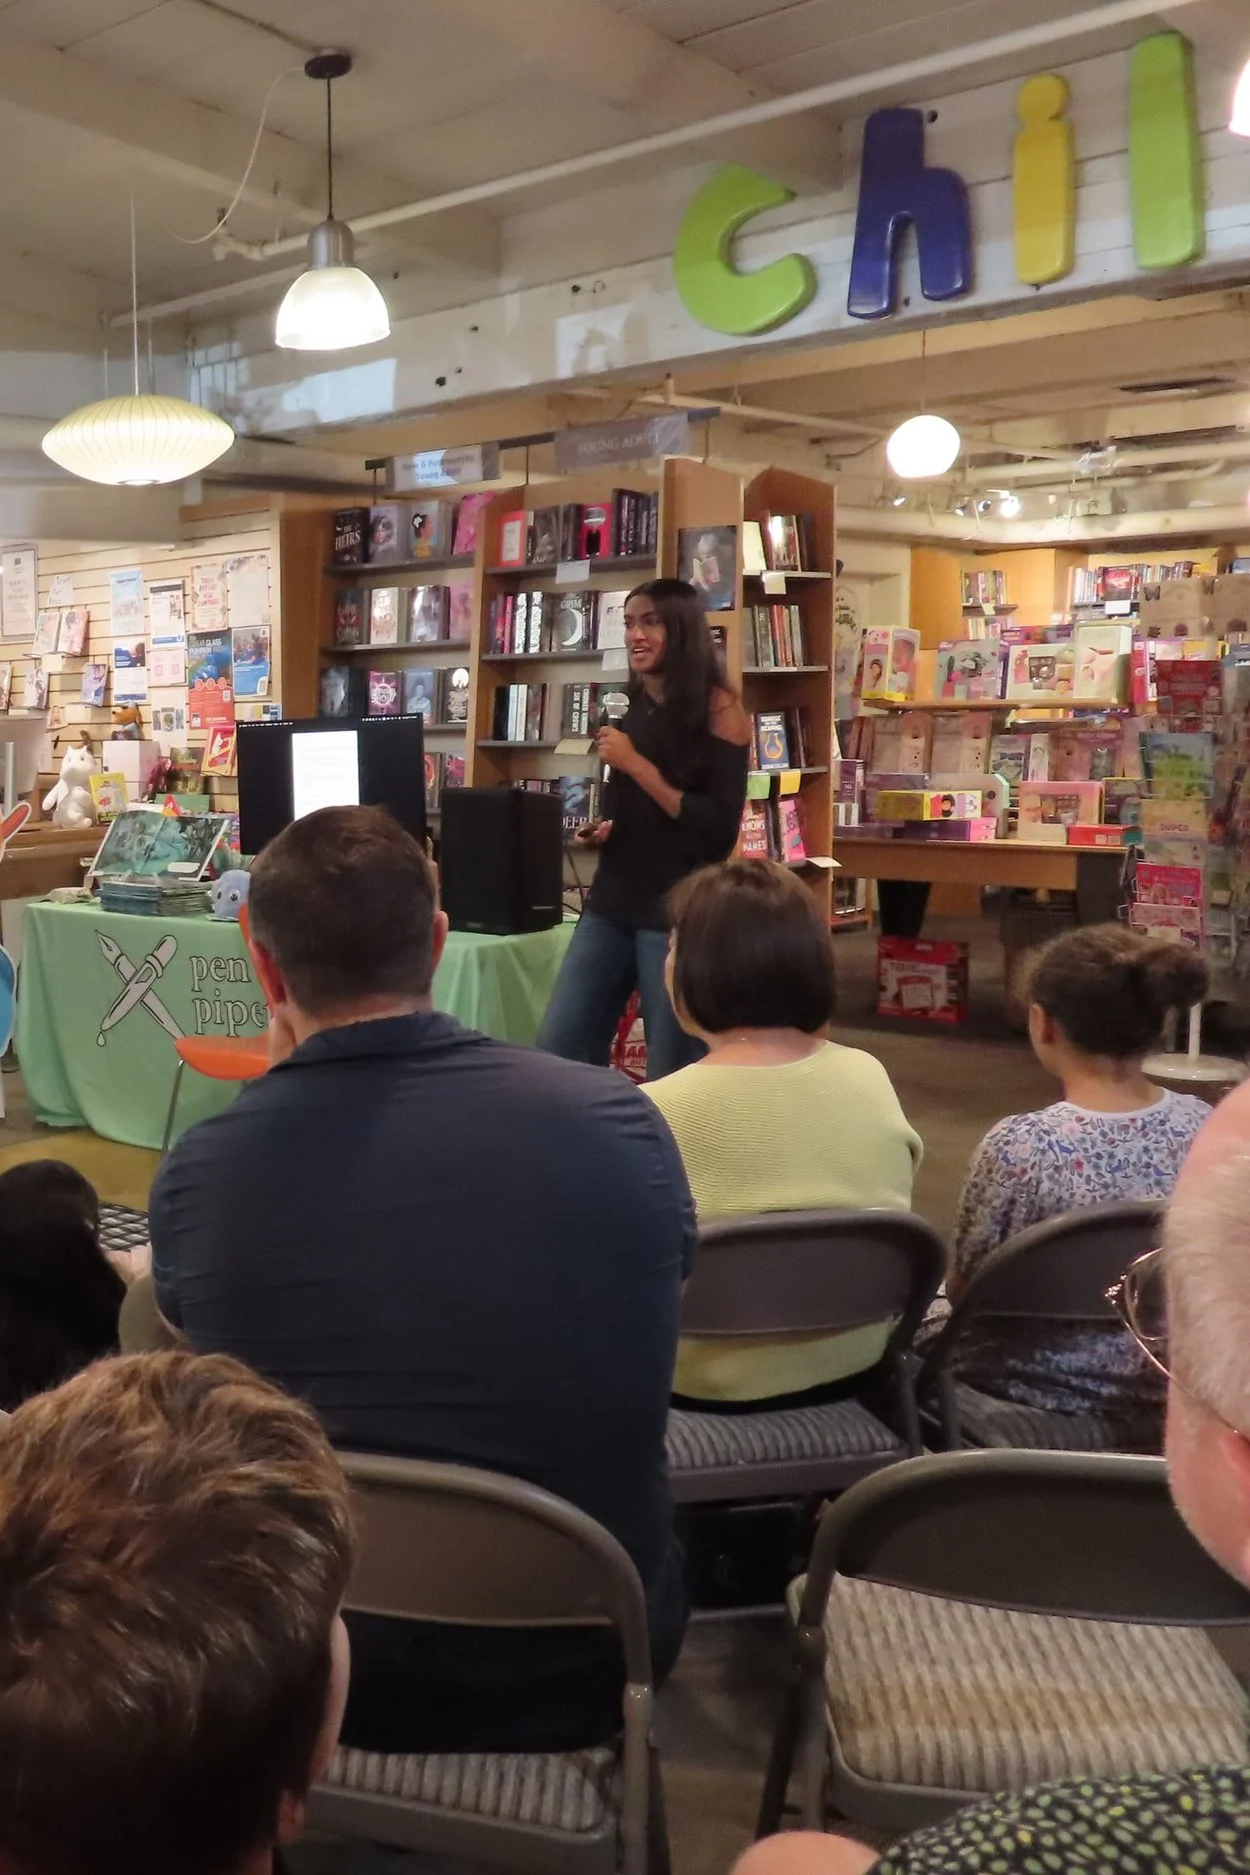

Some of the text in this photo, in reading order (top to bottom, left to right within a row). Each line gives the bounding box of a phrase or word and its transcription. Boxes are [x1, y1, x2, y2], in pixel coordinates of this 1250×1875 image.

[622, 432, 660, 449] ADULT
[335, 530, 362, 550] HEIRS
[206, 637, 222, 646] GLASS
[742, 840, 767, 852] NAMES
[189, 955, 252, 993] pen
